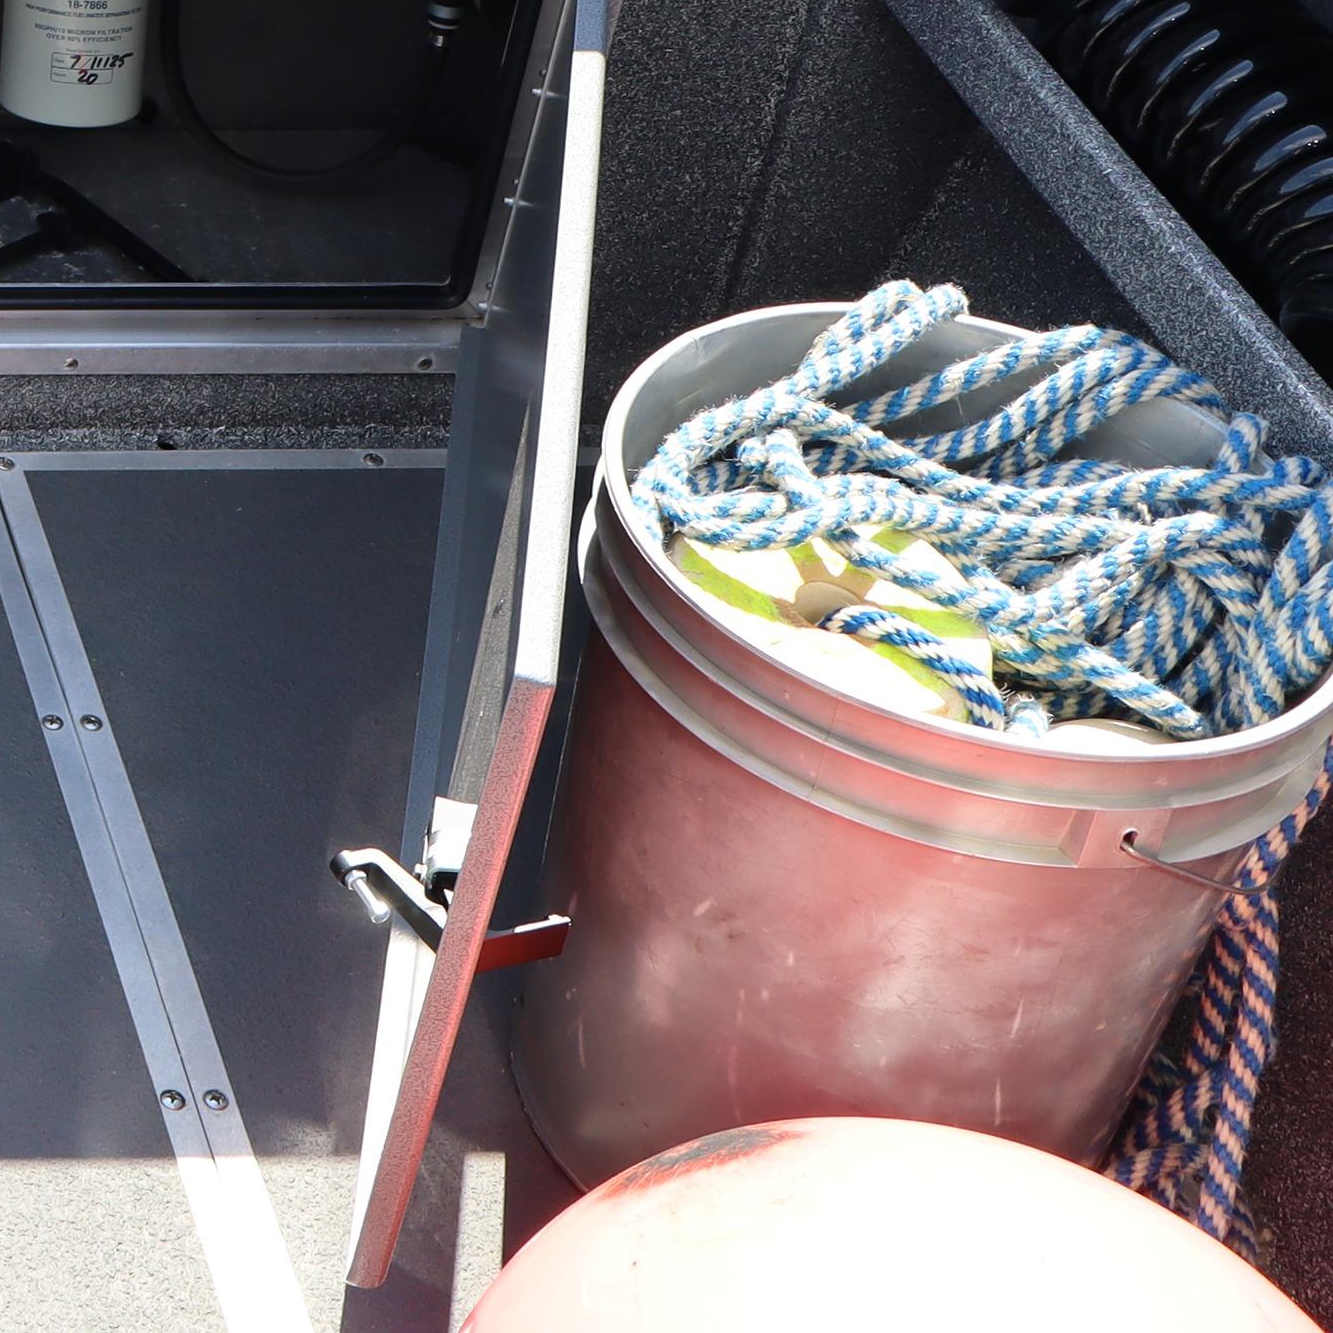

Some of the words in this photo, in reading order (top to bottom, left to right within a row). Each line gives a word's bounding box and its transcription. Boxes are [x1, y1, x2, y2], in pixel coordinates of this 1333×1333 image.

[68, 0, 109, 10] 18-7866
[46, 32, 65, 41] OVER
[77, 69, 99, 85] 20
